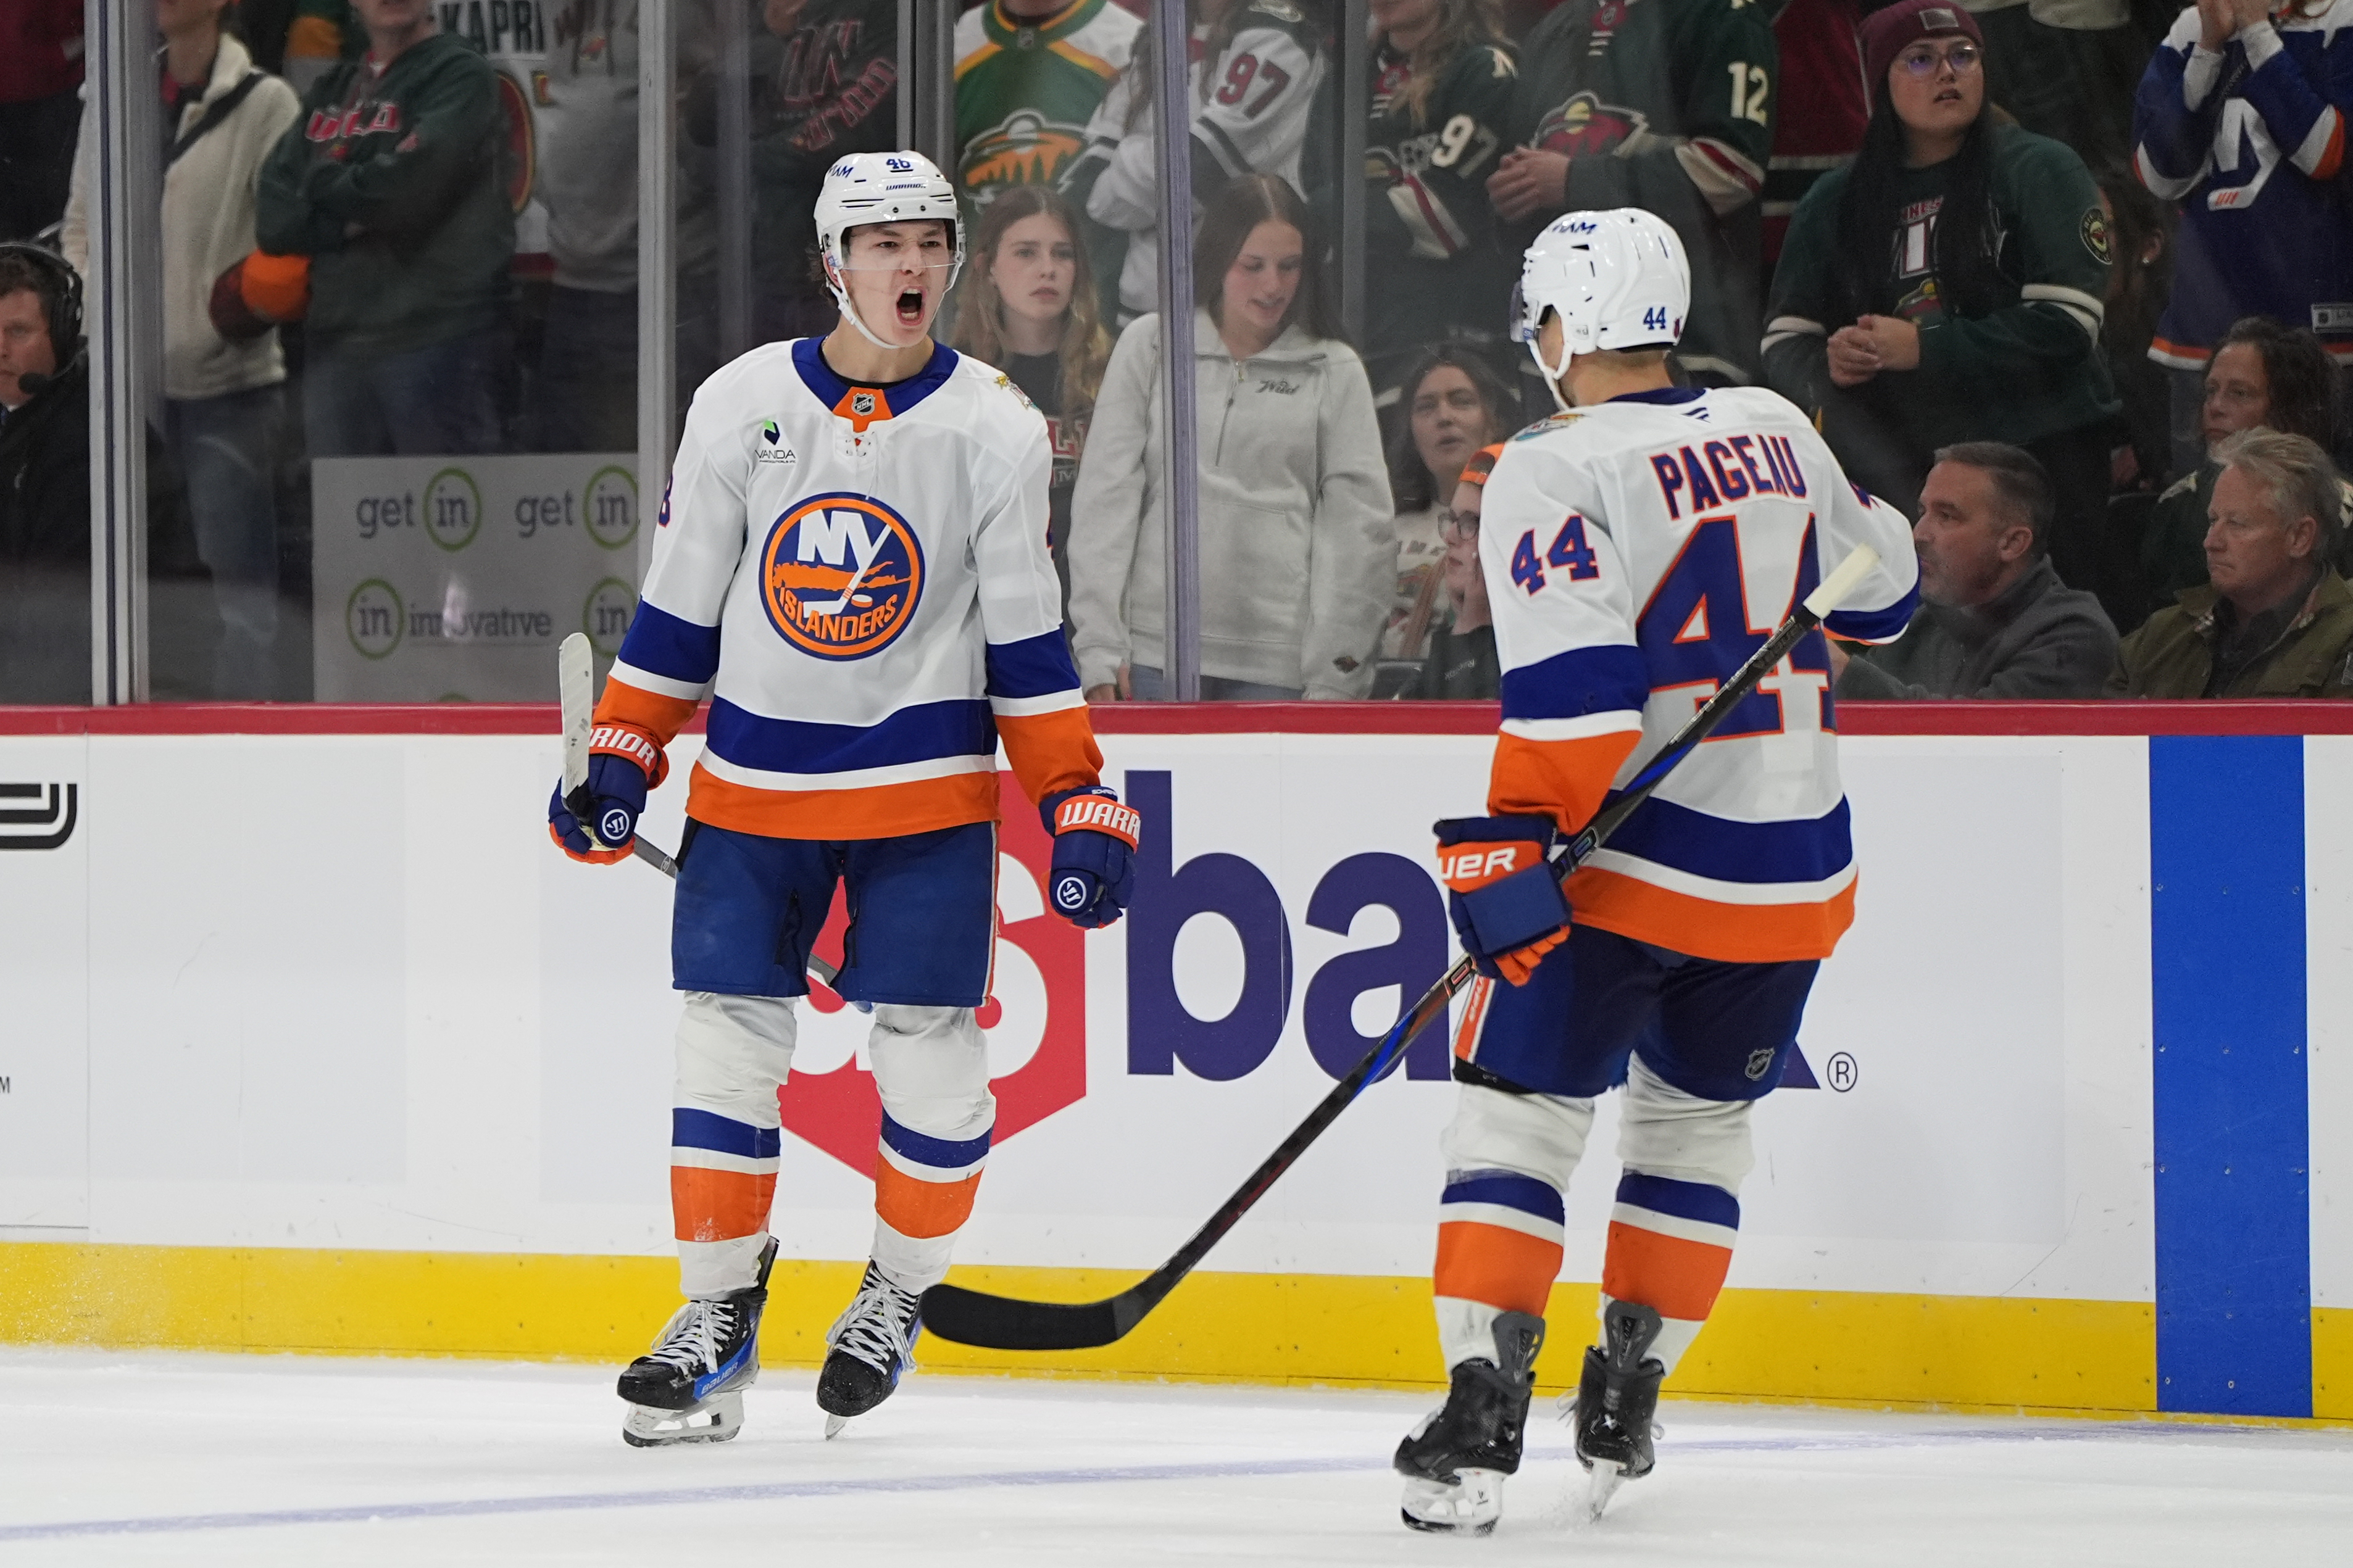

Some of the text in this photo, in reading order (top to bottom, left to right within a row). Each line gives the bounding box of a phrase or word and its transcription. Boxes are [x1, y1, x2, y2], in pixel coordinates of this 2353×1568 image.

[1215, 52, 1291, 120] 97
[1728, 62, 1769, 128] 12
[1643, 306, 1667, 331] 44
[754, 449, 796, 459] VANDA
[1649, 433, 1807, 521] PAGEAU
[356, 485, 470, 539] get in
[514, 483, 630, 538] get in
[1510, 514, 1601, 598] 44
[357, 594, 392, 637] in
[779, 586, 898, 642] ISLANDERS
[589, 727, 656, 767] RIOR
[701, 1361, 739, 1395] BAUER
